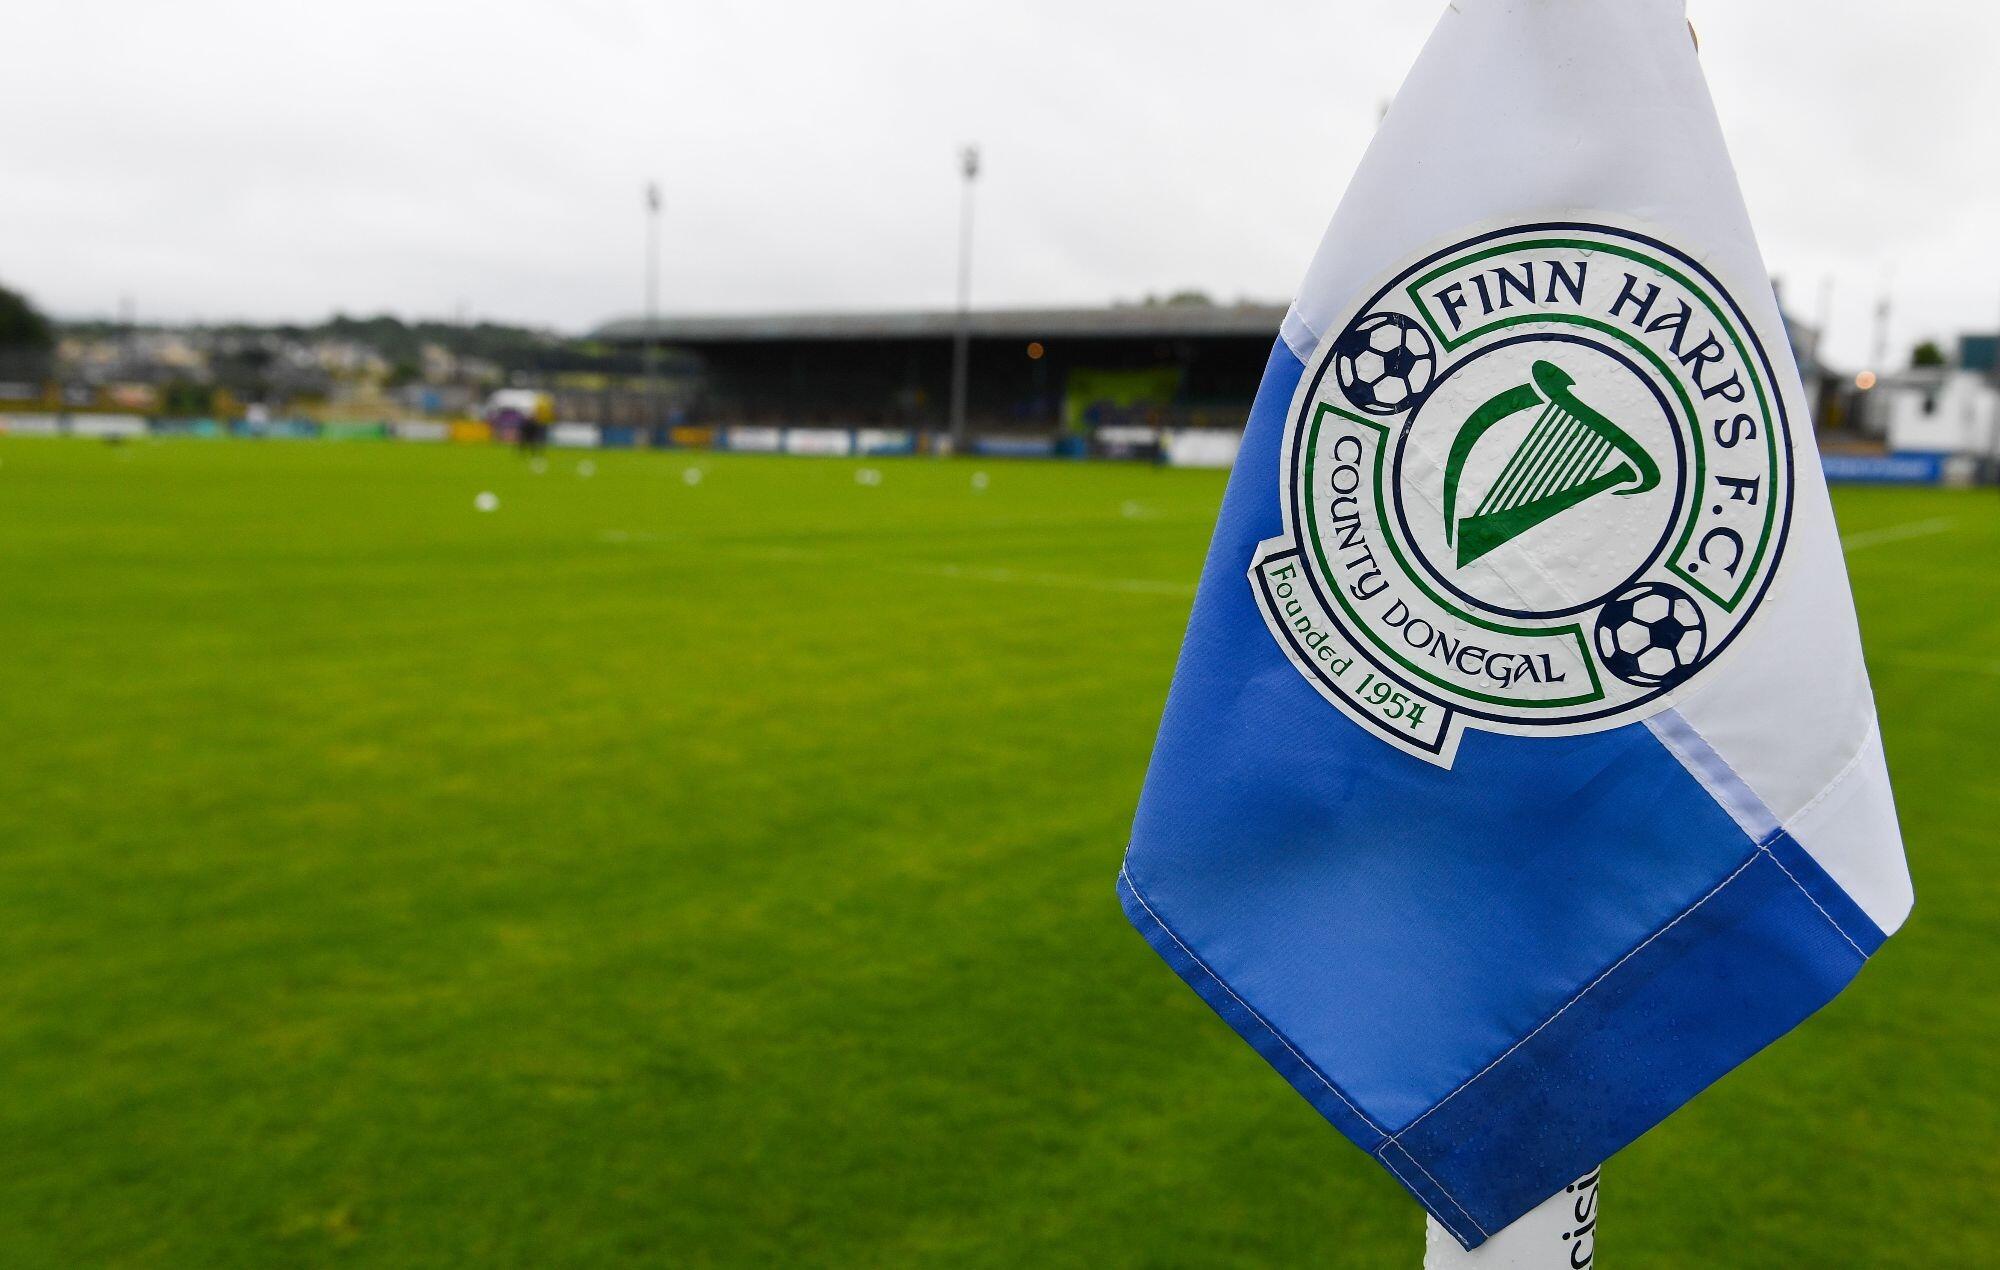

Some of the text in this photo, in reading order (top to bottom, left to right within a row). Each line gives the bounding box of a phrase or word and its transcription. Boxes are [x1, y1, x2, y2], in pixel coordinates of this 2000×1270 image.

[1432, 260, 1761, 579] FINN HARPS F.C.
[1269, 561, 1428, 730] Founded 1954
[1330, 435, 1566, 689] COUNTY DONEGAL
[1562, 1170, 1600, 1270] cisi
